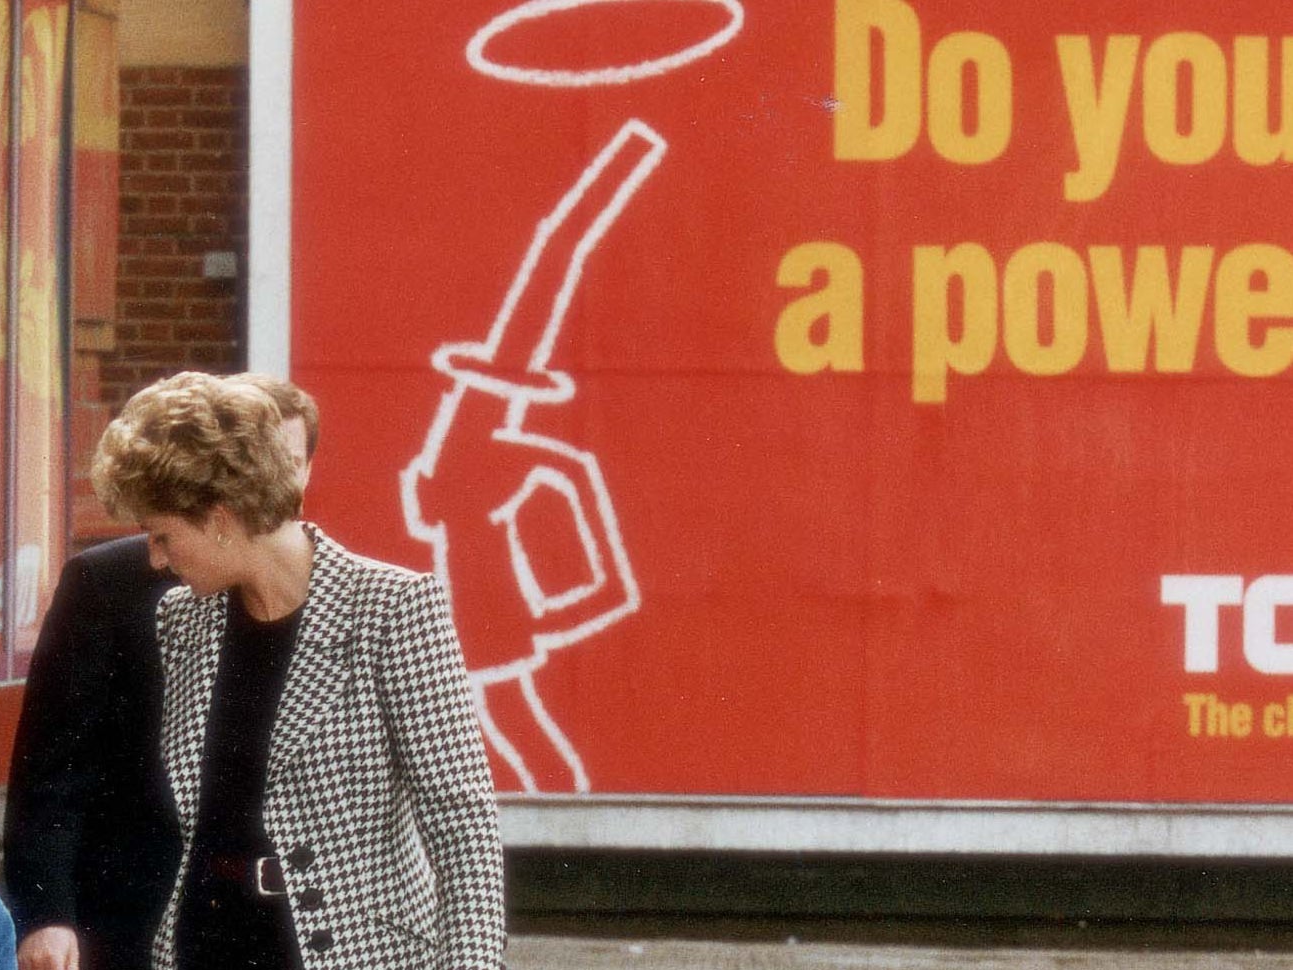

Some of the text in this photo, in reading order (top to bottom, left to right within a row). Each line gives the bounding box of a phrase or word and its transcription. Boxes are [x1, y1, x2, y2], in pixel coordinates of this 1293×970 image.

[833, 0, 1293, 202] Do you
[774, 241, 865, 375] a
[1183, 693, 1254, 738] The
